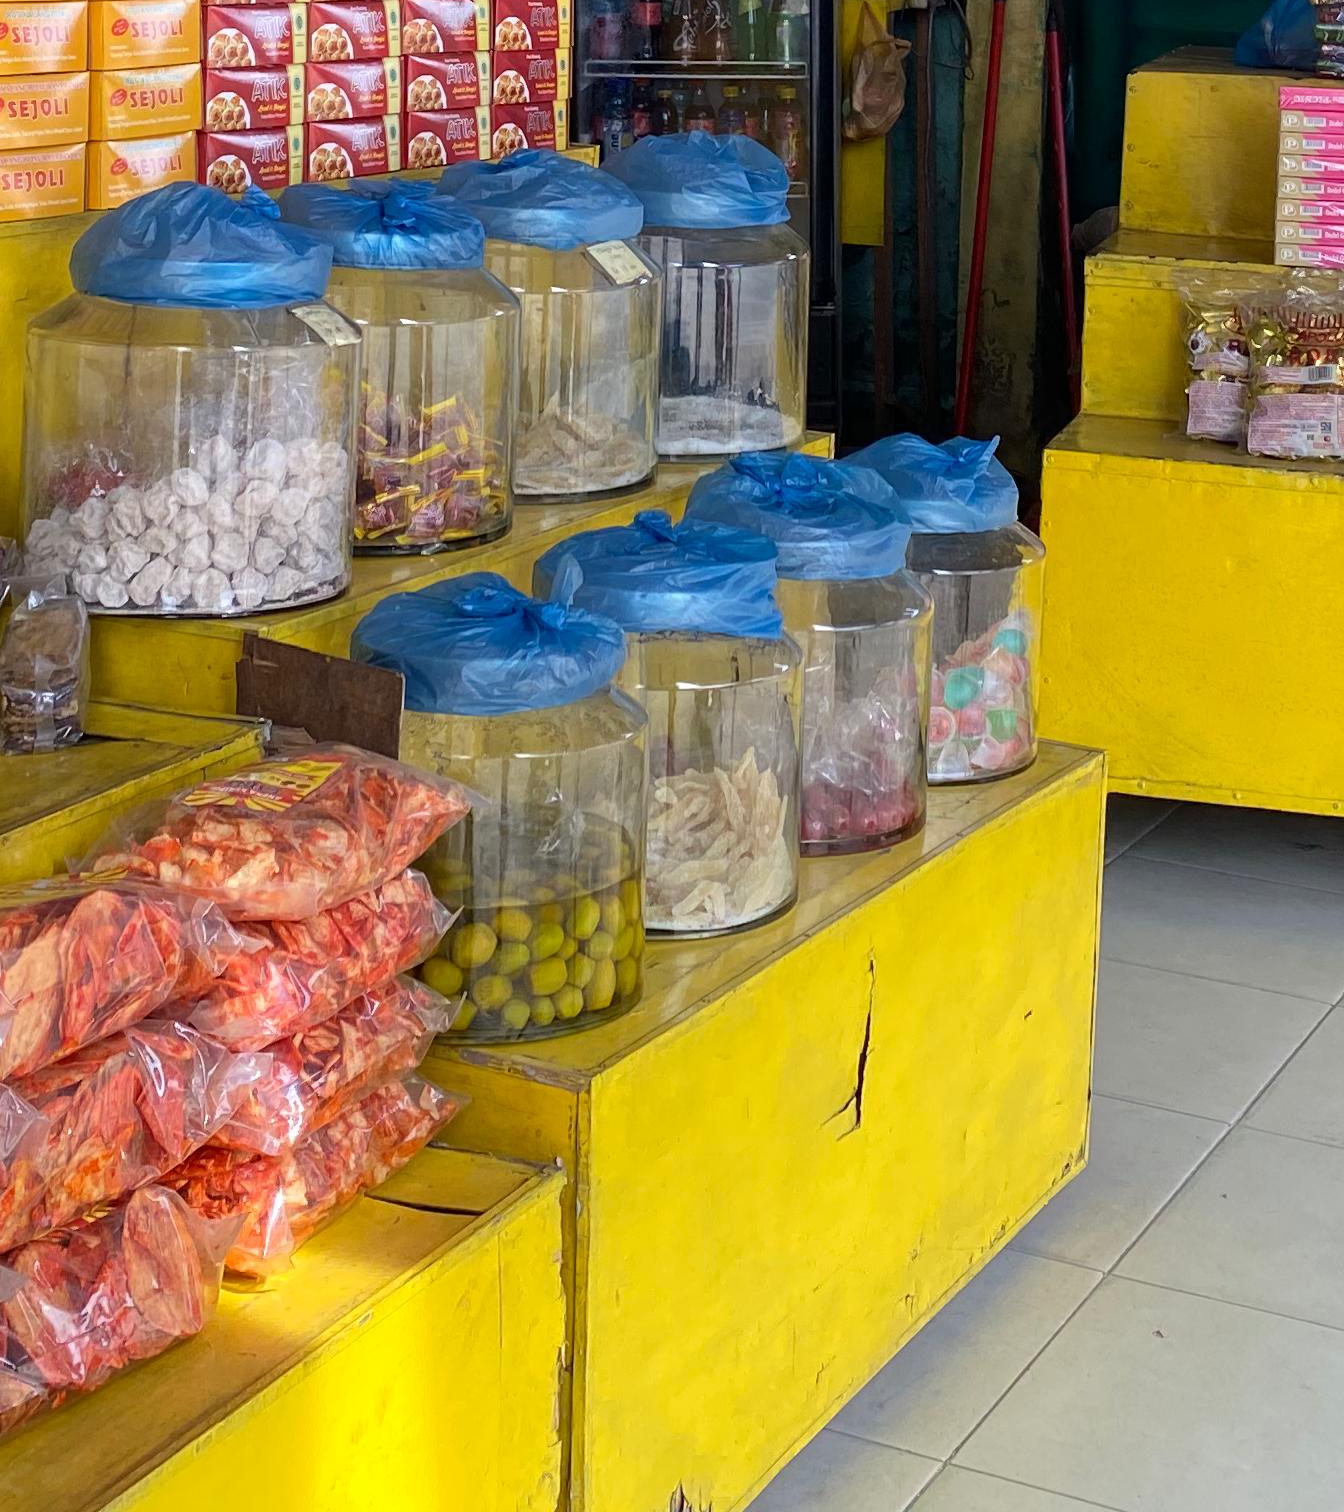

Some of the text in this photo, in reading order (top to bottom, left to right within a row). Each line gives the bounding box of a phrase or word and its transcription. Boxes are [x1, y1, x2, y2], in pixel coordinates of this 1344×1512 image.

[11, 23, 71, 46] SEJOLI
[130, 18, 184, 39] SEJOLI
[446, 62, 477, 84] ATIK
[129, 87, 185, 109] SEJOLI
[251, 75, 288, 102] ATIK
[7, 96, 70, 119] SEJOLI
[252, 138, 287, 165] ATIK
[128, 153, 183, 177] SEJOLI
[0, 167, 65, 191] SEJOLI
